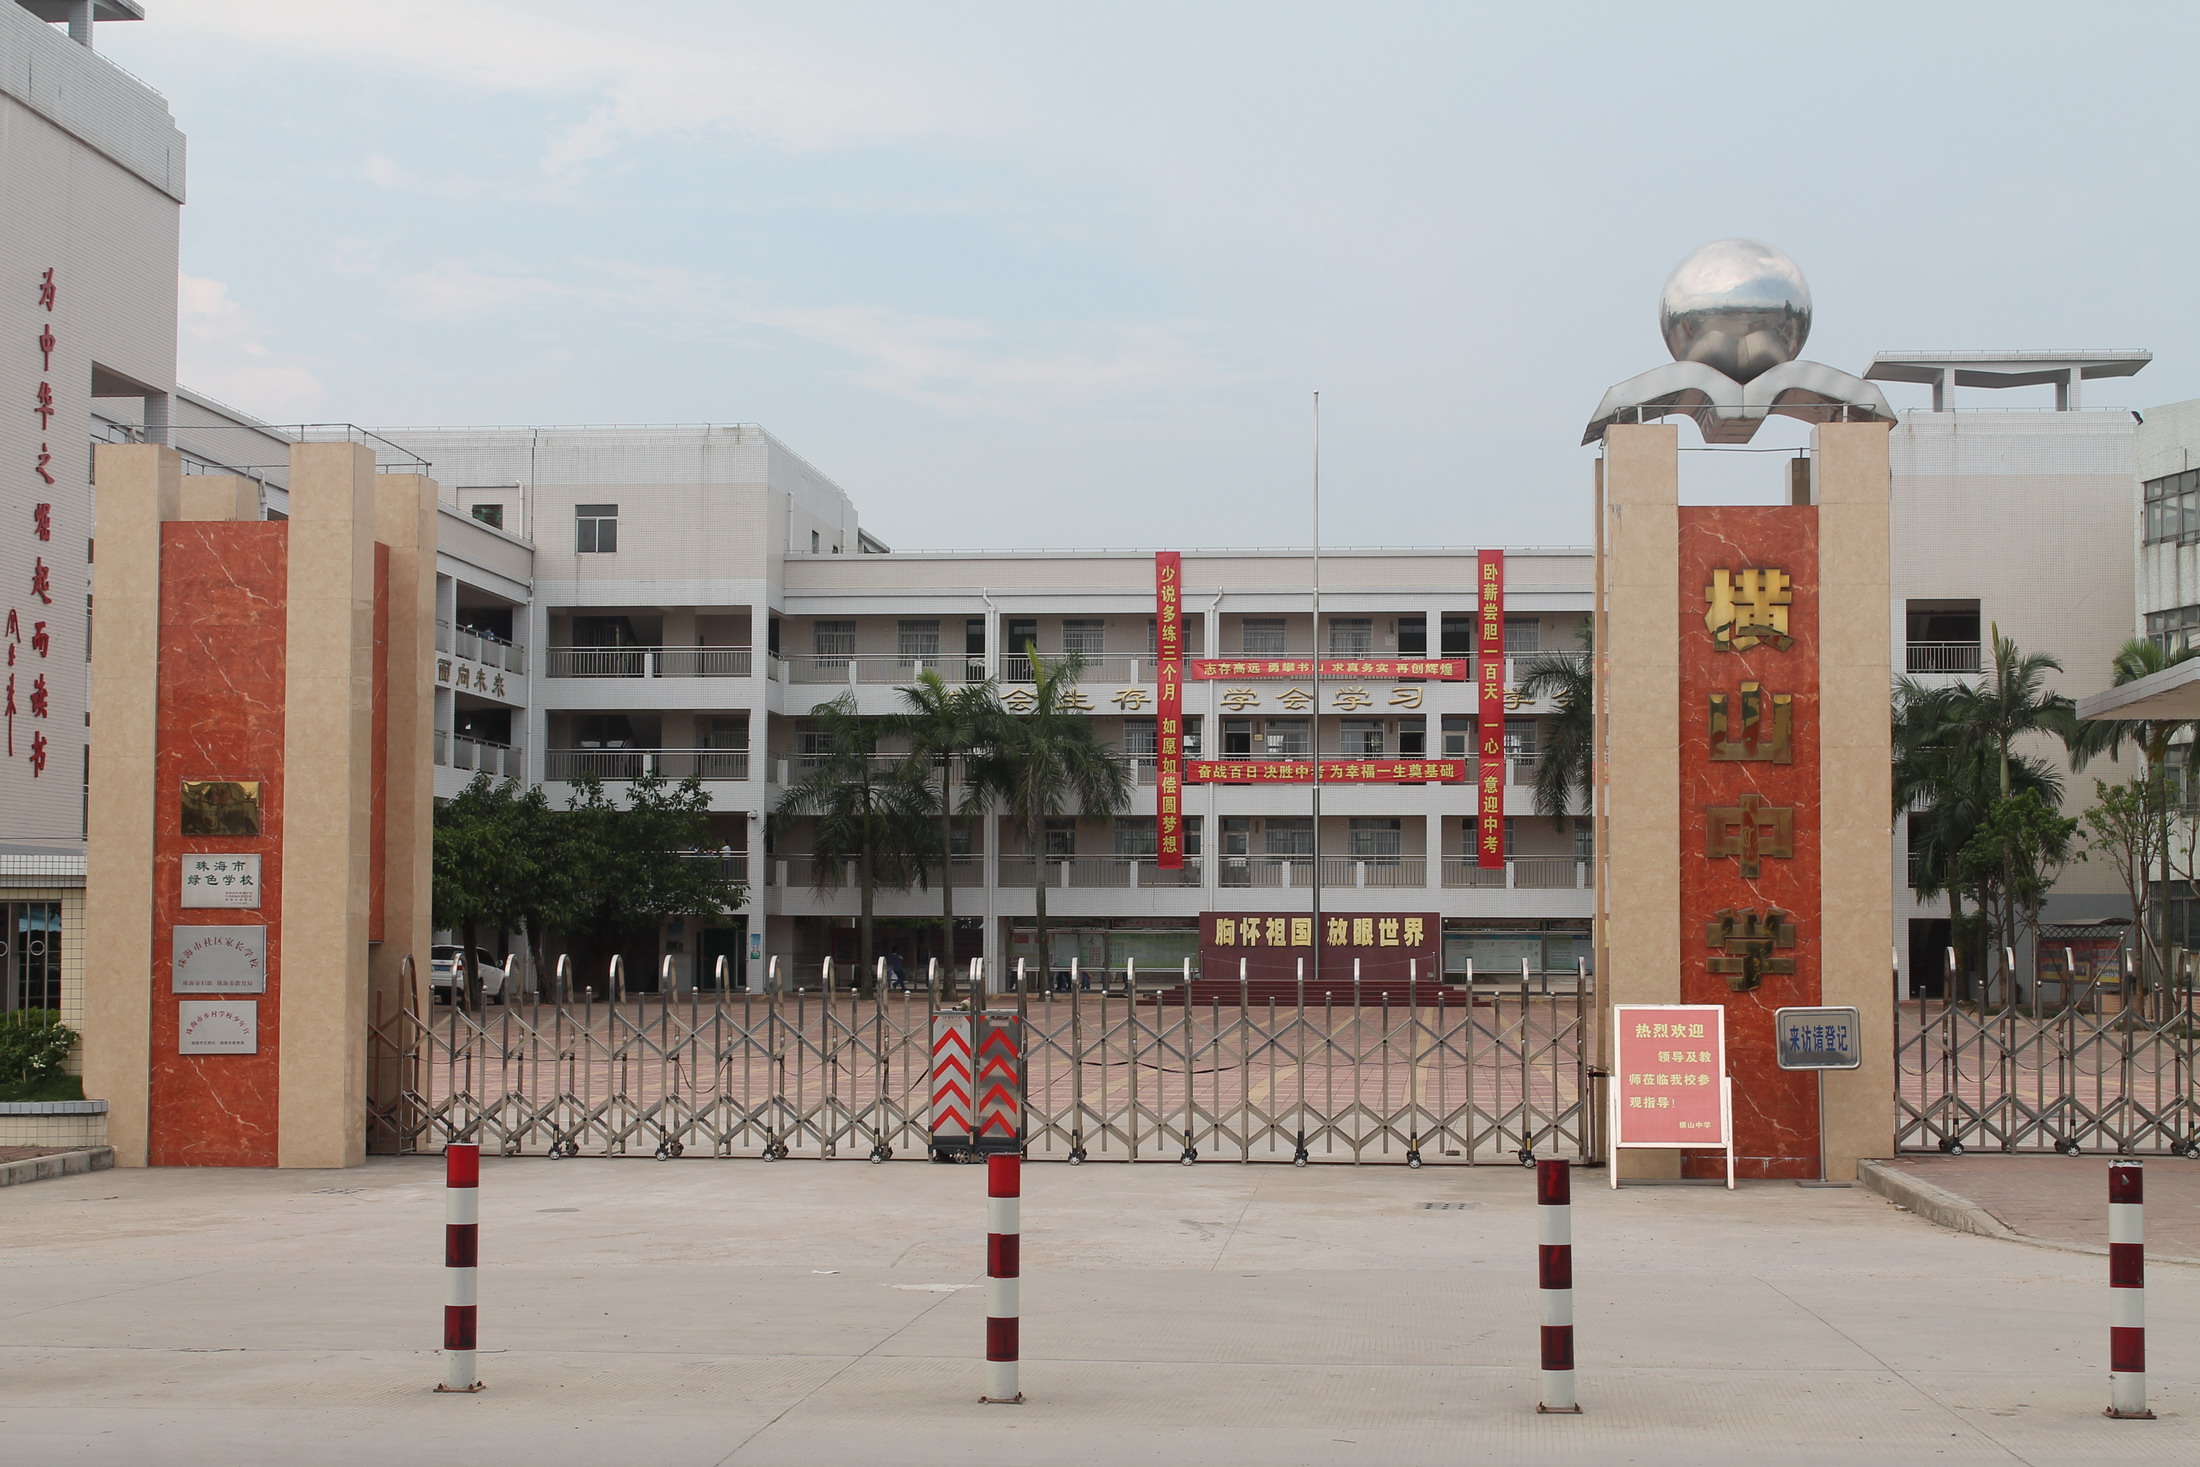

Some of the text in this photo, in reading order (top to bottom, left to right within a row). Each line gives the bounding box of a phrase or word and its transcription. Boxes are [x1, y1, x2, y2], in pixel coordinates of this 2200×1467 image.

[1204, 662, 1260, 676] 志存高远
[1332, 662, 1389, 673] 求真务实
[1395, 662, 1454, 676] 再创辉煌
[437, 658, 505, 698] 面向未来
[1220, 686, 1423, 711] 学会学习
[1161, 565, 1178, 853] 少说多练三个月 如愿如偿圆梦想
[1483, 563, 1499, 854] 卧薪尝胆一百天 一心一意迎中考
[1198, 764, 1257, 779] 奋战百日
[1330, 763, 1454, 779] 为幸福一生奠基础
[1705, 568, 1796, 992] 横山中学
[196, 860, 246, 872] 珠海市
[187, 874, 254, 886] 绿色学校
[1215, 917, 1424, 947] 胸怀祖国 放眼世界
[1635, 1023, 1704, 1038] 热烈欢迎
[1789, 1025, 1848, 1052] 来访请登记
[1658, 1050, 1712, 1063] 领导及教
[1629, 1073, 1711, 1086] 师莅临我校参
[1679, 1121, 1712, 1129] 横山中学
